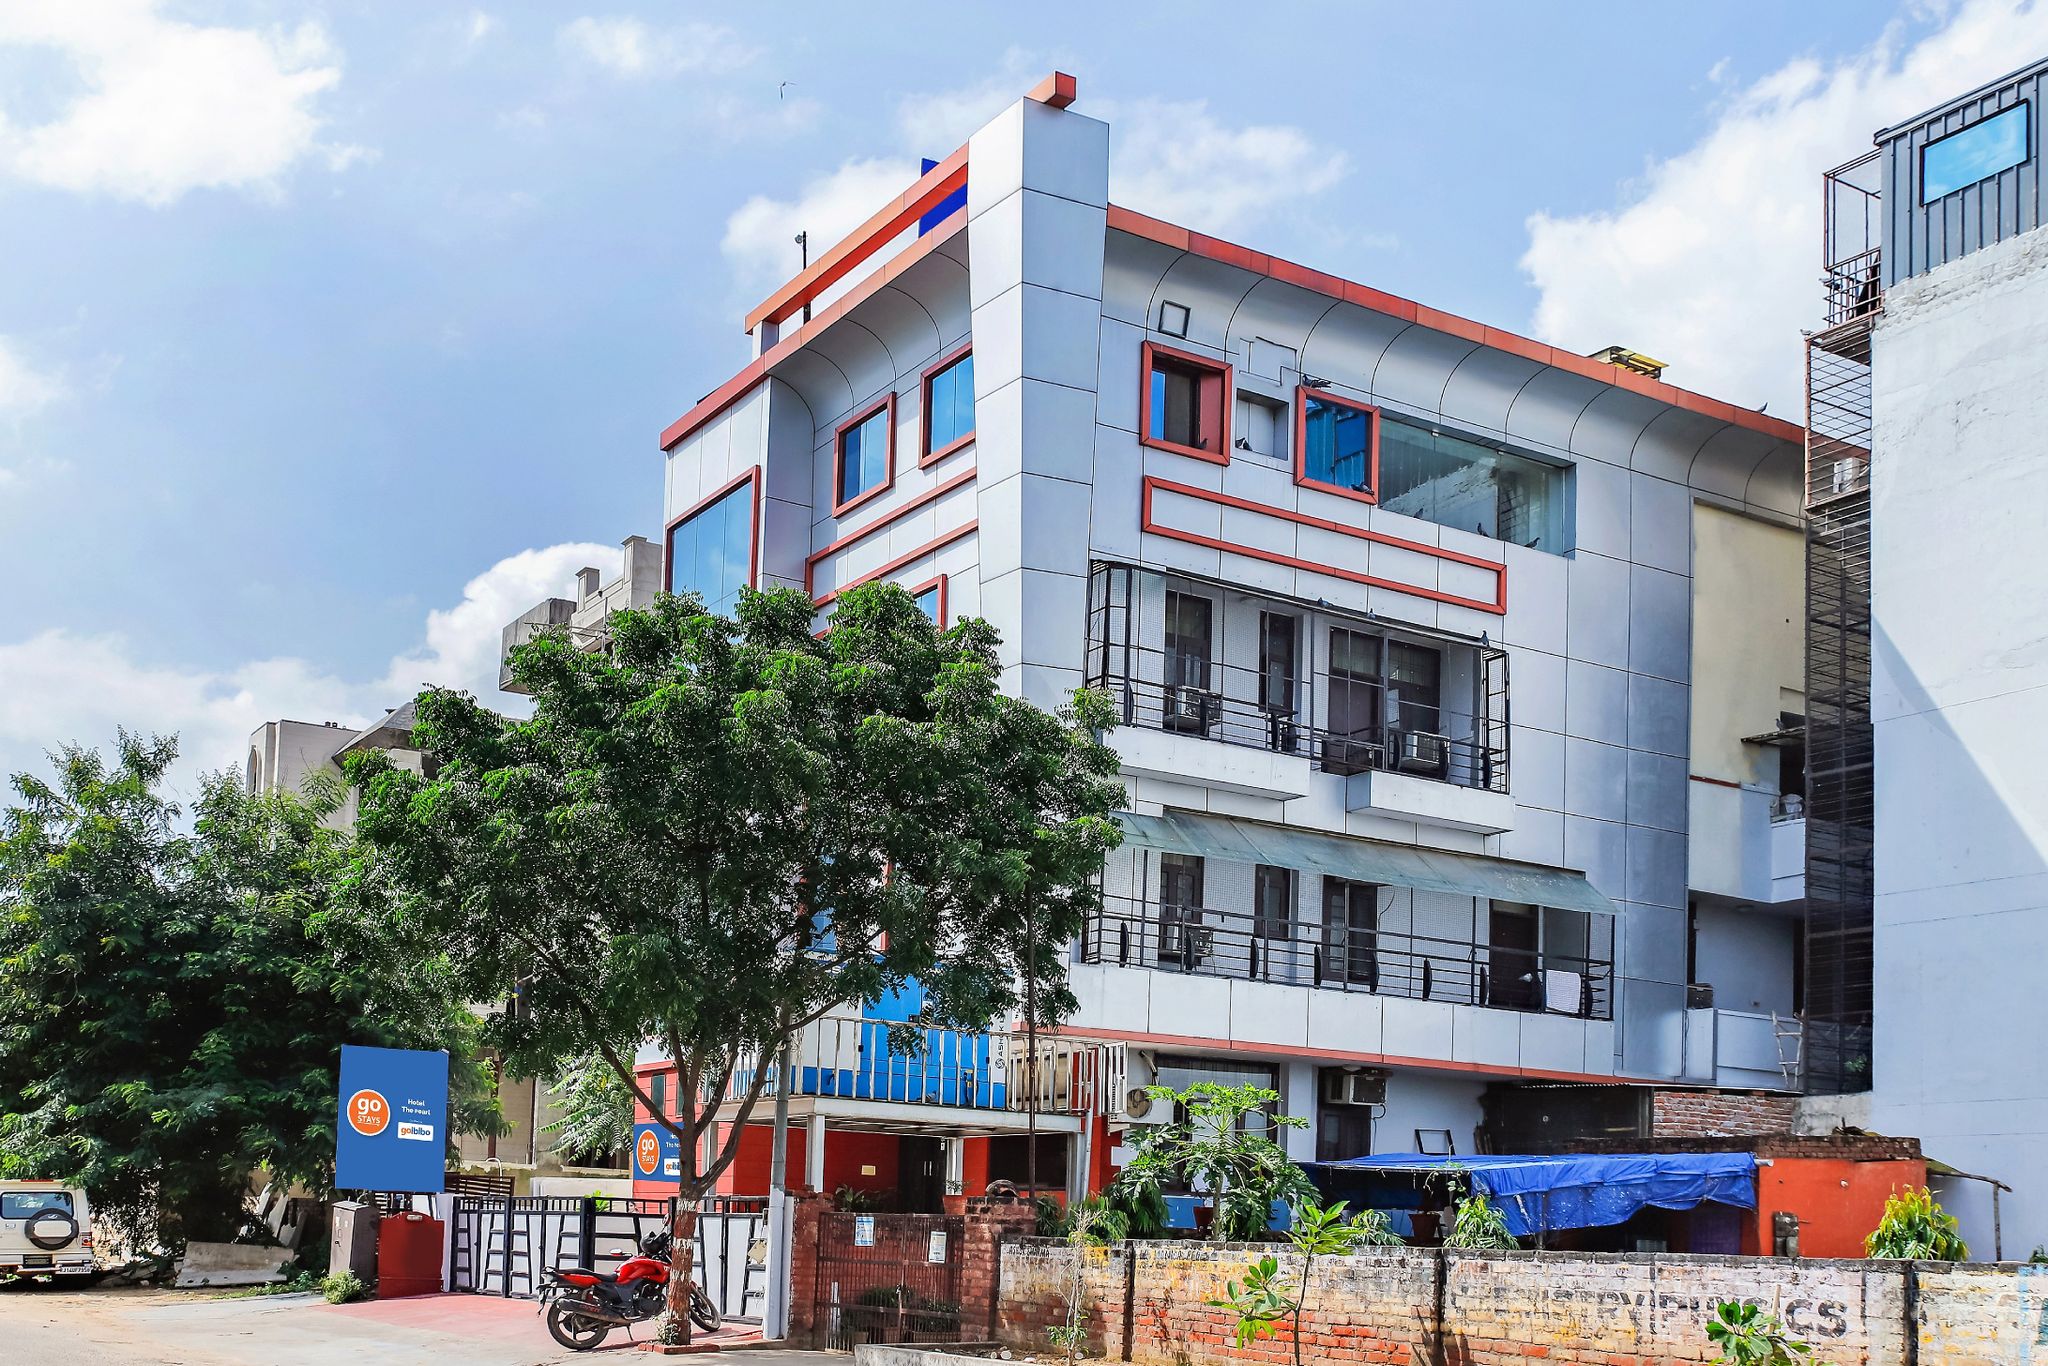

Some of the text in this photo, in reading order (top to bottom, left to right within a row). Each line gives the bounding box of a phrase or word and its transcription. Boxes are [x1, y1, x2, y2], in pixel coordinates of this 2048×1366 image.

[357, 1097, 382, 1115] go
[407, 1098, 425, 1107] Hotel
[401, 1106, 414, 1114] The
[357, 1115, 381, 1125] STAYS
[400, 1126, 431, 1136] goibibo
[642, 1139, 655, 1155] go
[1658, 1293, 1850, 1339] PHCS
